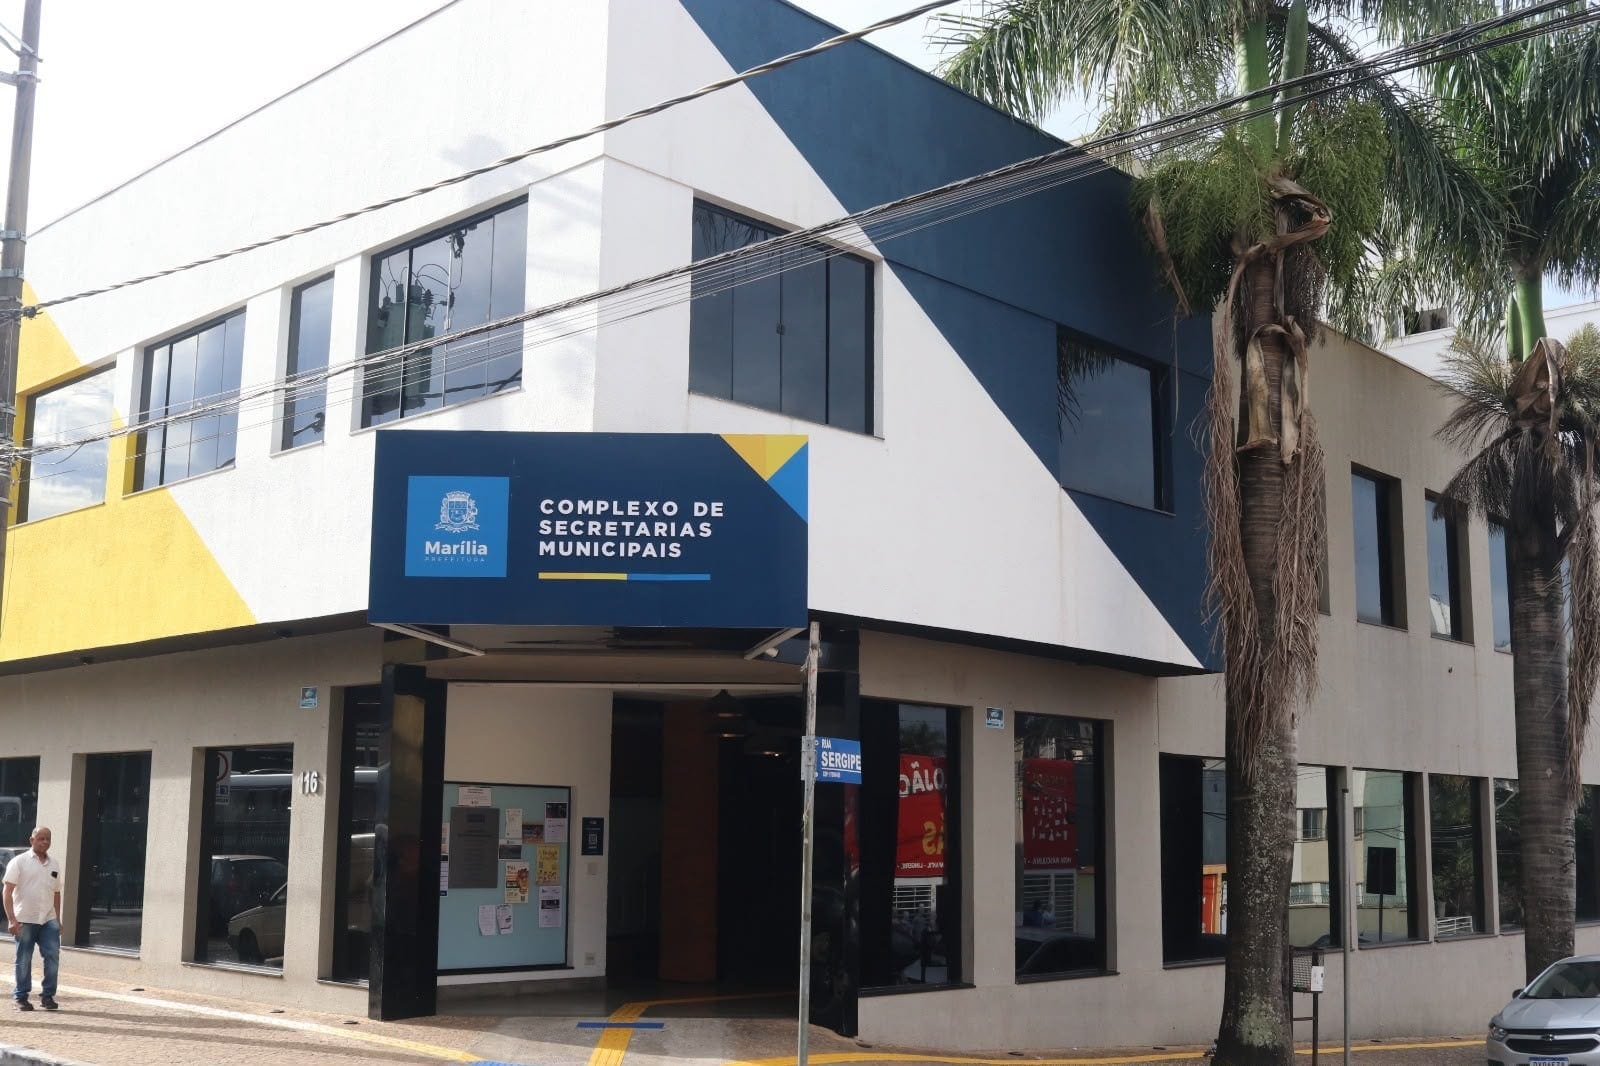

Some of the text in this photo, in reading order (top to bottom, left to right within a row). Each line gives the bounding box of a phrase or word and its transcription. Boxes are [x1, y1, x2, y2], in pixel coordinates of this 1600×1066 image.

[540, 499, 724, 517] COMPLEXO DE
[538, 520, 712, 537] SECRETARIAS
[425, 540, 488, 555] Marília
[539, 541, 682, 558] MUNICIPAIS
[821, 738, 831, 749] RUA
[821, 751, 861, 770] SERGIPE
[299, 770, 318, 793] 116
